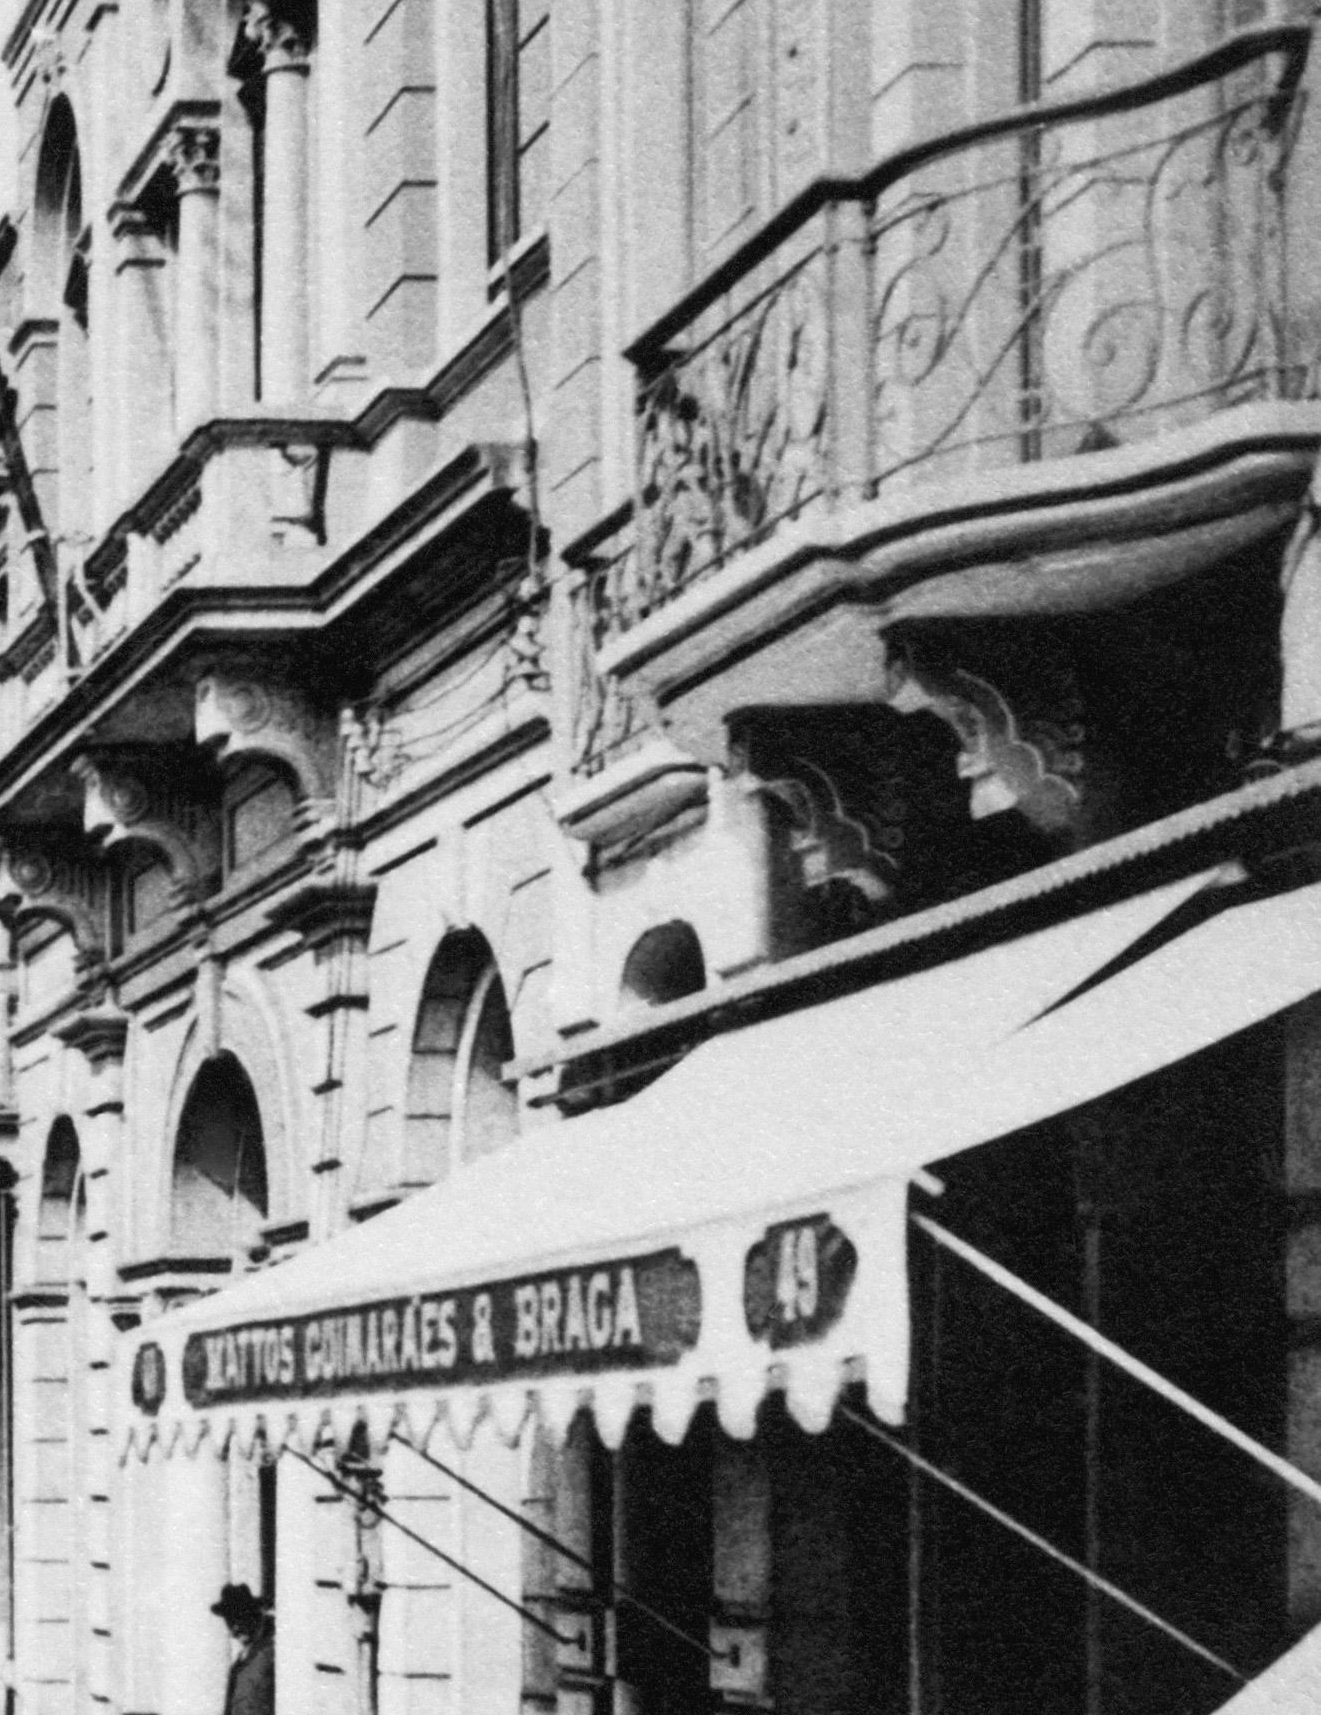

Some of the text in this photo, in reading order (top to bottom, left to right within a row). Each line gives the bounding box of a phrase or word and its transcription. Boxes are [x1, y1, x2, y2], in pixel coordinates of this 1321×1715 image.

[471, 1292, 496, 1363] &
[514, 1266, 643, 1358] BRAGA
[776, 1225, 819, 1322] 49
